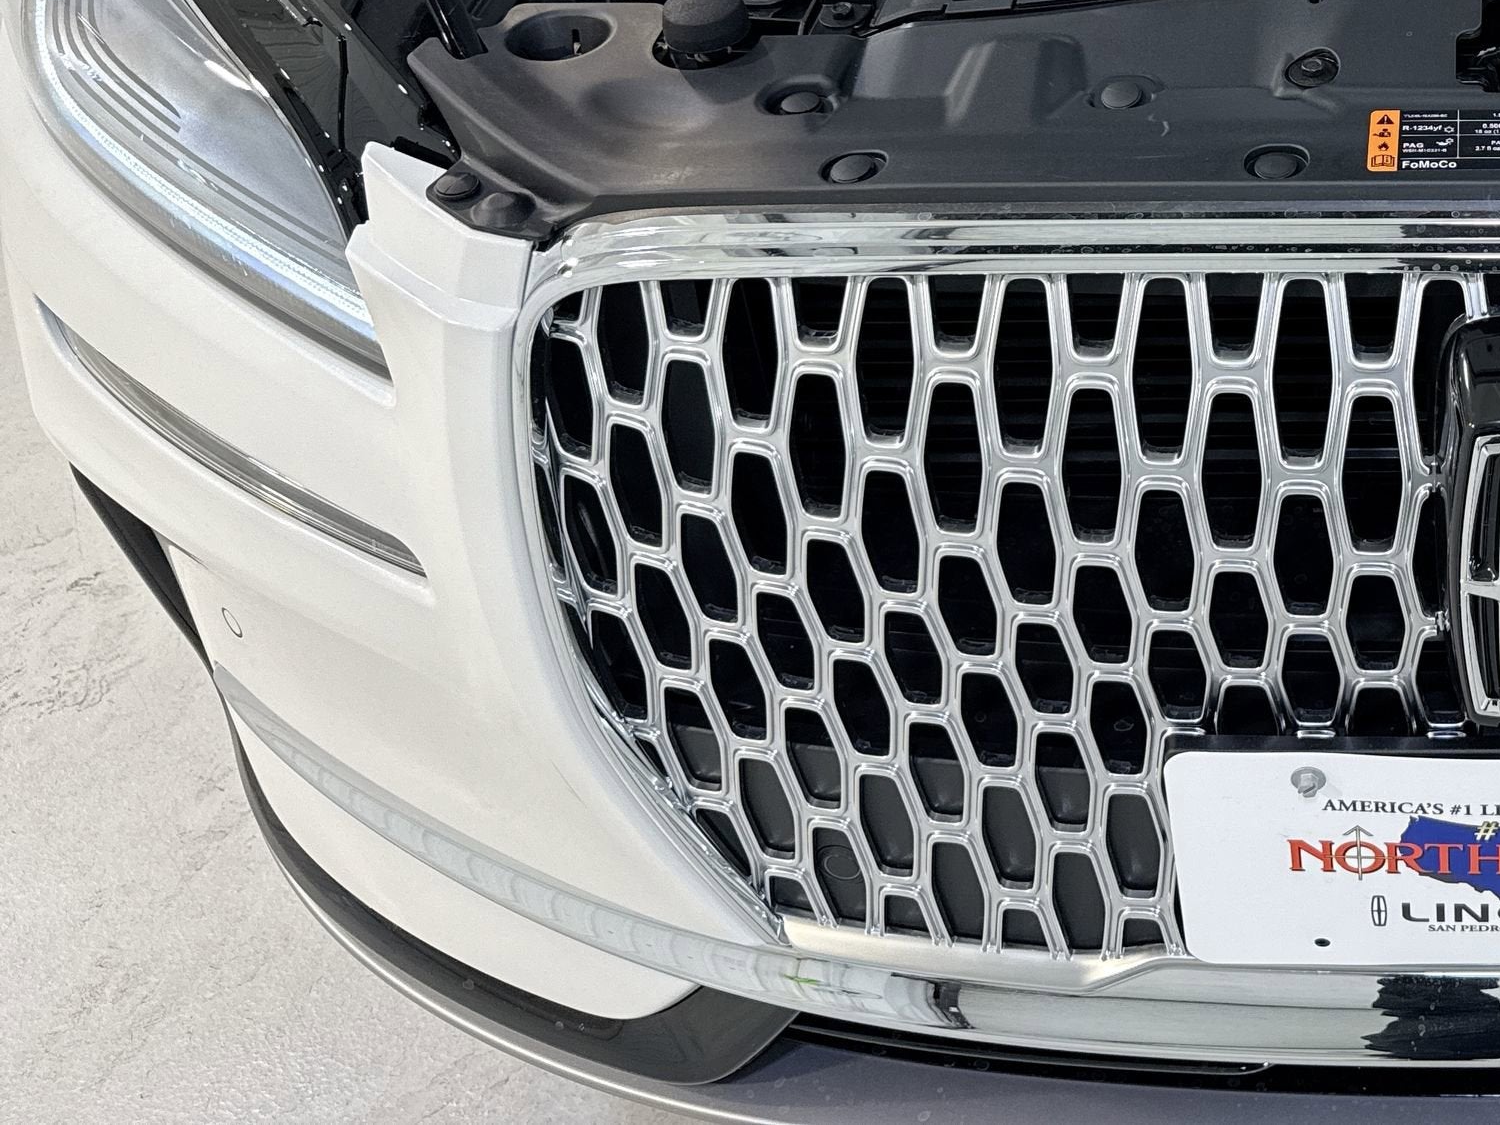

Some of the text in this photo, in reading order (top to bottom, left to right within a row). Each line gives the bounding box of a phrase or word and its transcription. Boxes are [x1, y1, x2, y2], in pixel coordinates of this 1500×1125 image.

[1401, 160, 1457, 169] FoMoCo
[1321, 798, 1444, 815] AMERICA'S
[1449, 804, 1473, 816] #1
